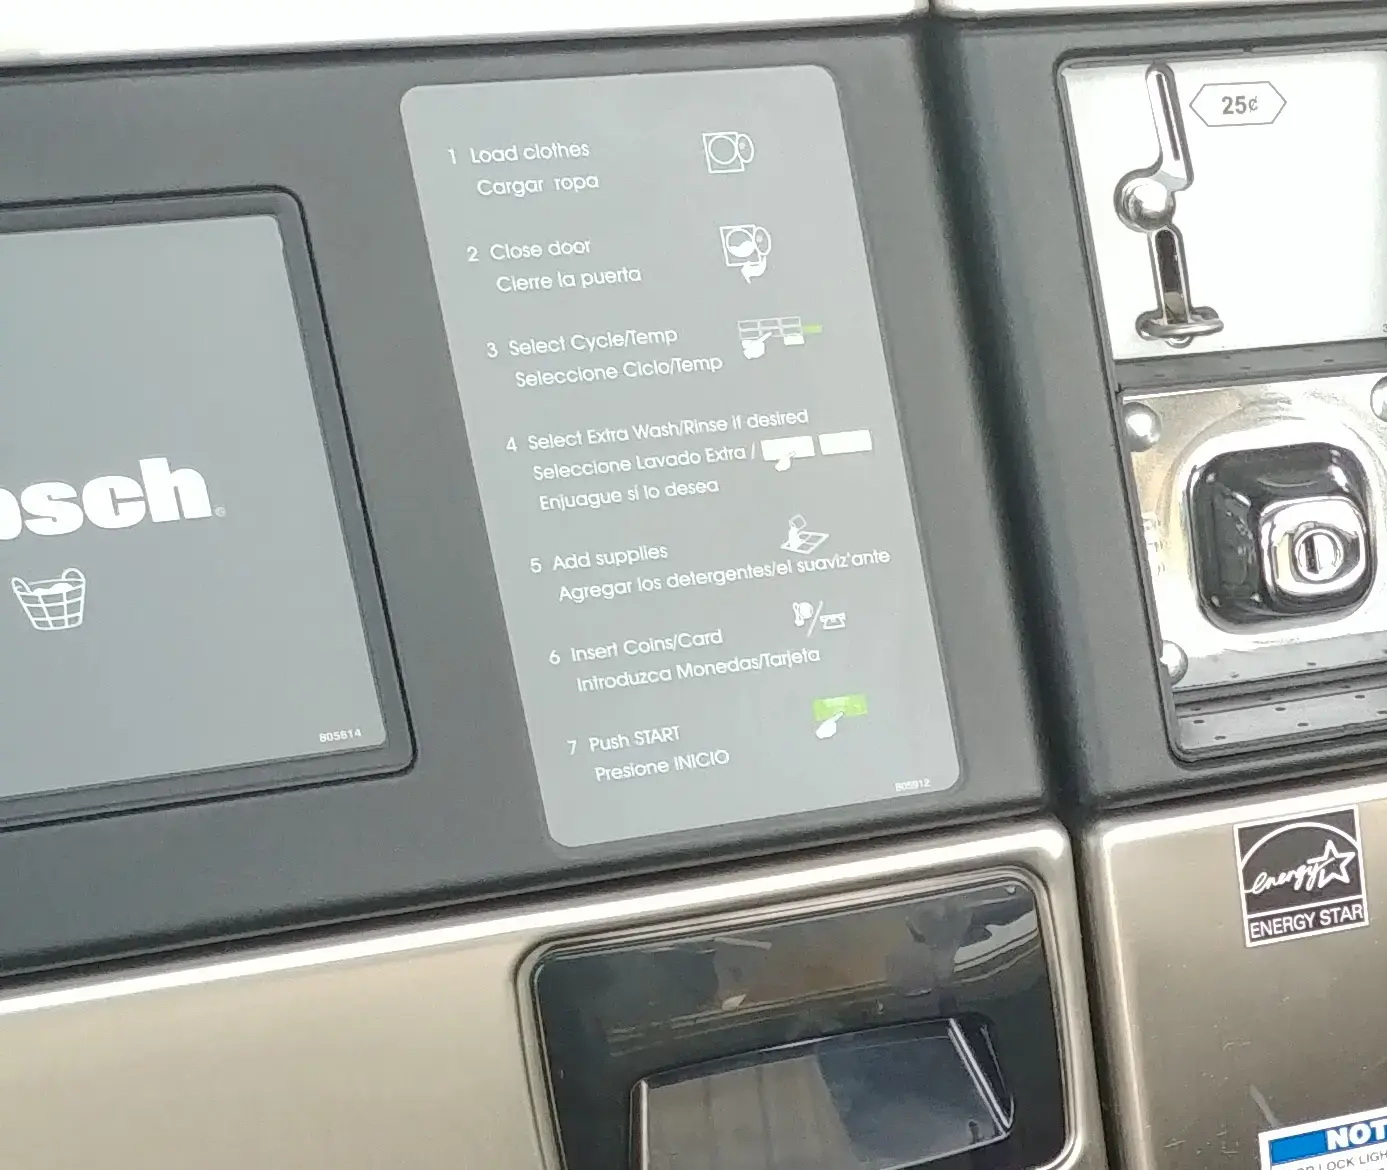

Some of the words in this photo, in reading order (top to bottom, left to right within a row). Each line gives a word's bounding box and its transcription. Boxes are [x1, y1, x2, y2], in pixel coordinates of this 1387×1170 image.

[1221, 95, 1258, 115] 25¢
[447, 148, 457, 165] 1
[469, 144, 519, 164] Load
[523, 142, 590, 160] clothes
[476, 179, 544, 198] Cargar
[553, 175, 600, 193] ropa
[466, 245, 480, 262] 2
[489, 243, 543, 261] Close
[547, 240, 591, 256] door
[495, 275, 553, 293] Cierre
[557, 270, 577, 288] la
[580, 266, 642, 289] puerta
[486, 341, 499, 358] 3
[508, 335, 566, 356] Select
[570, 329, 678, 352] Cycle/Temp
[515, 366, 619, 388] Seleccione
[622, 357, 723, 378] Ciclo/Temp
[506, 436, 518, 452] 4
[527, 430, 583, 451] Select
[586, 427, 630, 445] Extra
[631, 418, 728, 440] Wash/Rinse
[731, 414, 742, 430] if
[746, 408, 809, 429] desired
[533, 459, 632, 481] Seleccione
[635, 450, 702, 470] Lavado
[704, 446, 747, 463] Extra
[750, 441, 756, 460] /
[539, 490, 623, 512] Enjuague
[627, 484, 640, 501] si
[642, 484, 661, 500] lo
[664, 480, 720, 497] desea
[530, 557, 542, 574] 5
[552, 551, 592, 571] Add
[595, 544, 668, 567] supplies
[559, 581, 633, 604] Agregar
[636, 576, 662, 592] los
[666, 559, 793, 588] detergentes/el
[796, 549, 891, 573] suaviz'ante
[548, 649, 561, 665] 6
[570, 641, 618, 662] Insert
[623, 628, 724, 655] Coins/Card
[576, 668, 673, 692] Introduzca
[675, 647, 821, 679] Monedas/Tarjeta
[566, 739, 577, 756] 7
[588, 733, 630, 753] Push
[633, 725, 680, 746] START
[593, 760, 670, 782] Presione
[673, 749, 730, 771] INICIO
[1249, 912, 1317, 941] ENERGY
[1319, 903, 1364, 927] STAR
